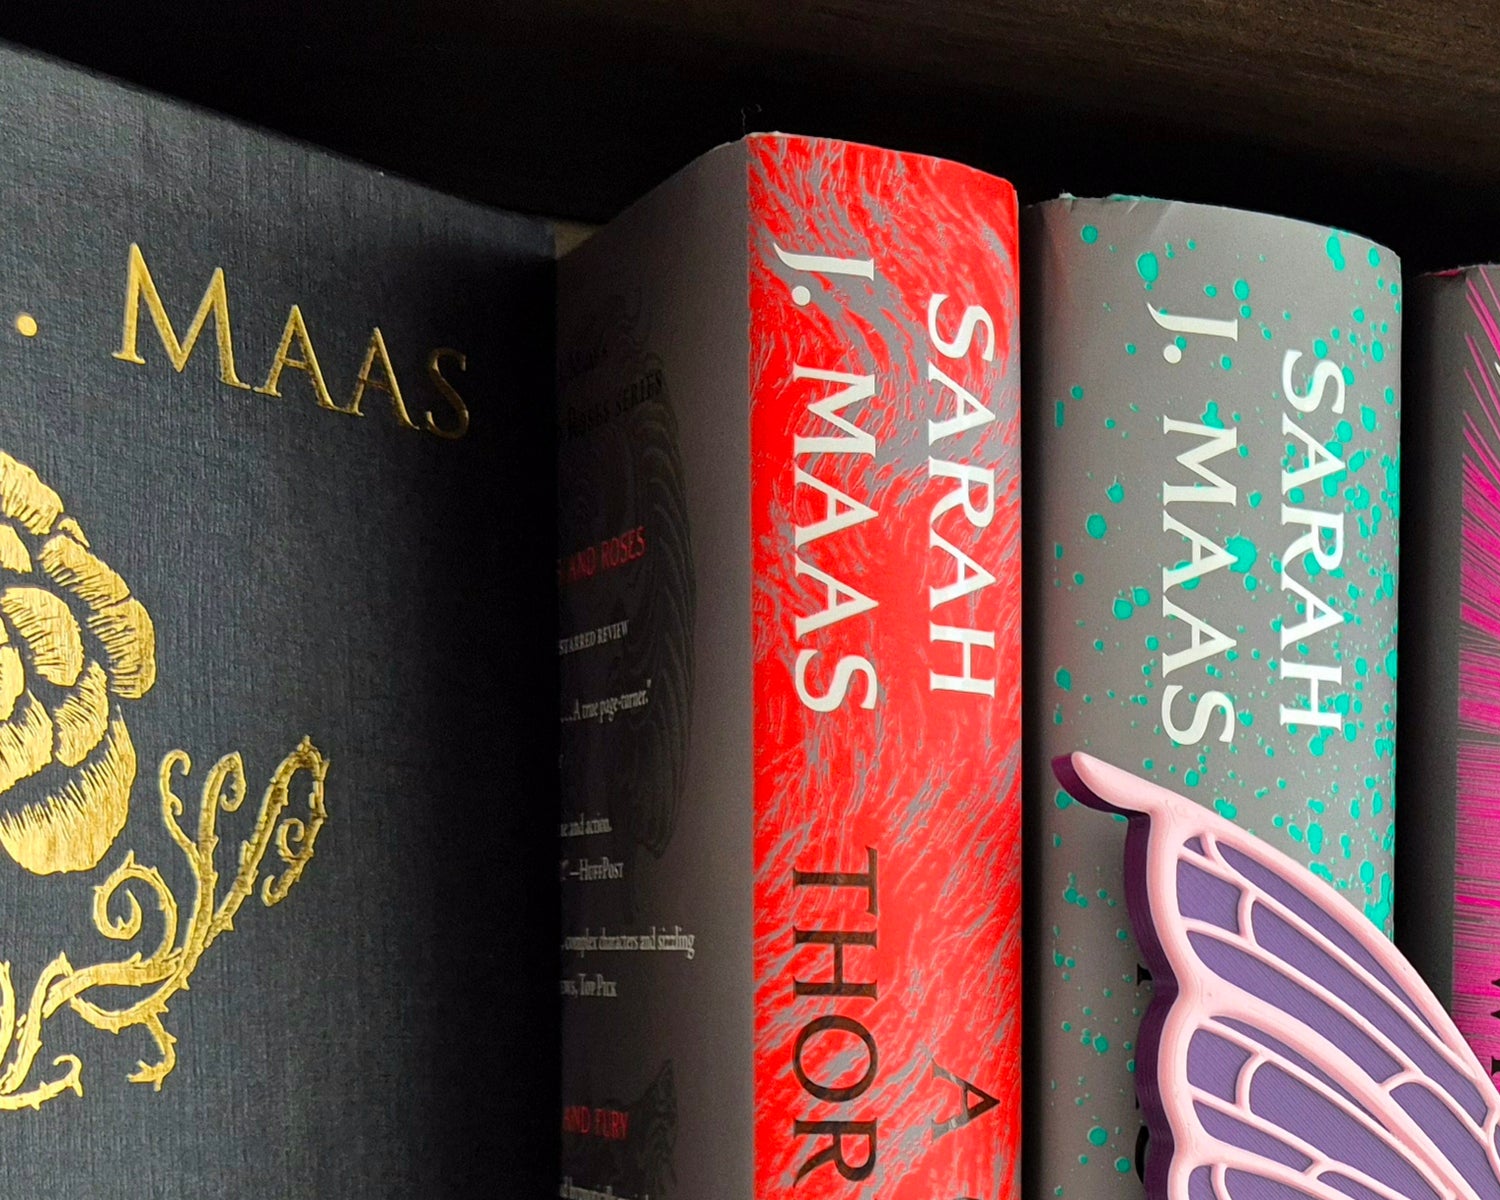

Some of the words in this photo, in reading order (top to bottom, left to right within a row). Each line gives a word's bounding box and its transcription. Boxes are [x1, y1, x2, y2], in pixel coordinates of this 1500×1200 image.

[773, 242, 875, 307] J.
[112, 242, 470, 440] MAAS
[1146, 301, 1239, 364] J.
[928, 291, 997, 699] SARAH
[601, 524, 648, 570] ROSES
[792, 363, 880, 715] MAAS
[1280, 348, 1347, 733] SARAH
[1161, 413, 1238, 747] MAAS
[597, 619, 630, 646] REVIEW
[598, 927, 638, 951] characters
[639, 926, 657, 951] and
[657, 925, 696, 960] sizzling
[563, 1105, 591, 1135] AND
[593, 1107, 631, 1142] FURY
[930, 1057, 1001, 1144] A
